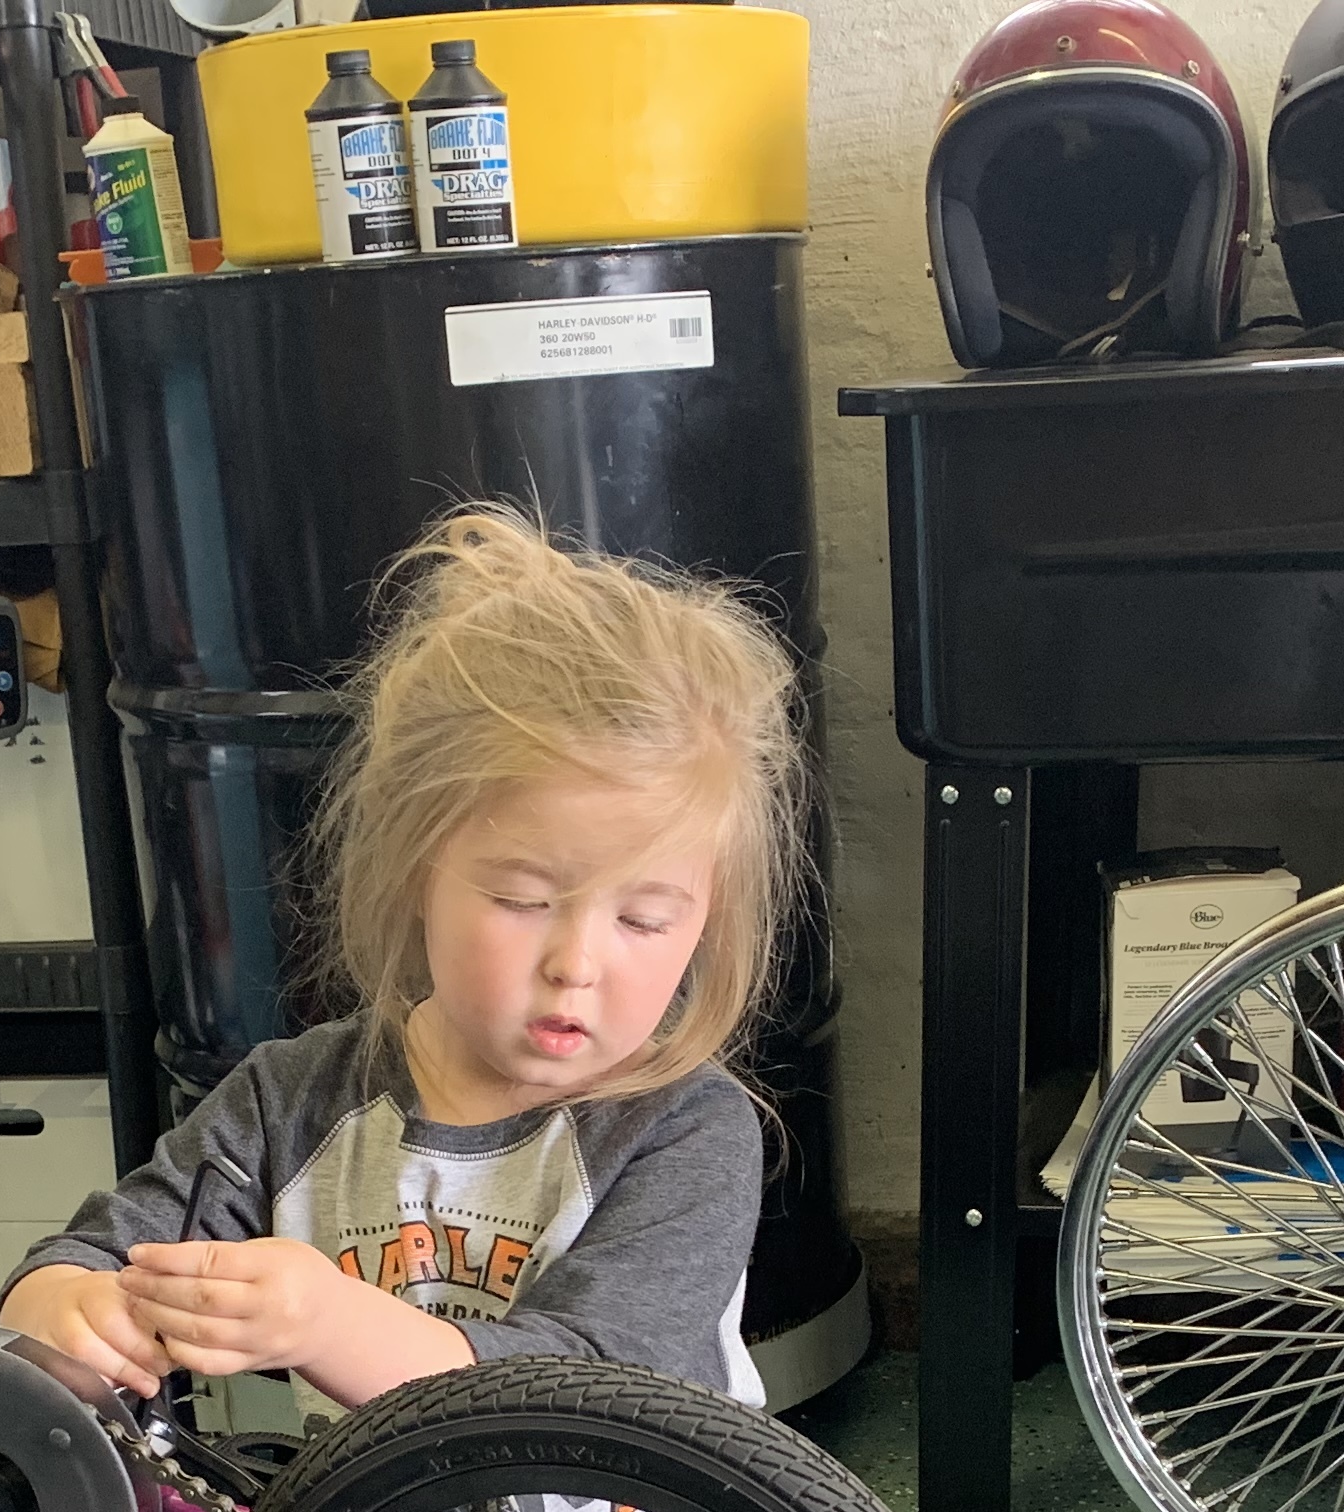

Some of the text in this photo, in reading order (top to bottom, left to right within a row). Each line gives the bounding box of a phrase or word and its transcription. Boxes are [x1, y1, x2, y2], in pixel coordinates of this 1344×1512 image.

[343, 123, 387, 158] BRAKE
[430, 118, 474, 150] BRAKE
[453, 147, 490, 160] DOT 4
[368, 155, 391, 167] DOT
[111, 169, 147, 200] Fluid
[441, 172, 503, 195] DRAG
[443, 189, 504, 203] Specialties
[539, 332, 596, 344] 360 20W50
[1193, 910, 1222, 924] Blue
[1124, 943, 1178, 955] Legendary
[1178, 942, 1201, 951] Blue
[338, 1219, 533, 1303] ARLE
